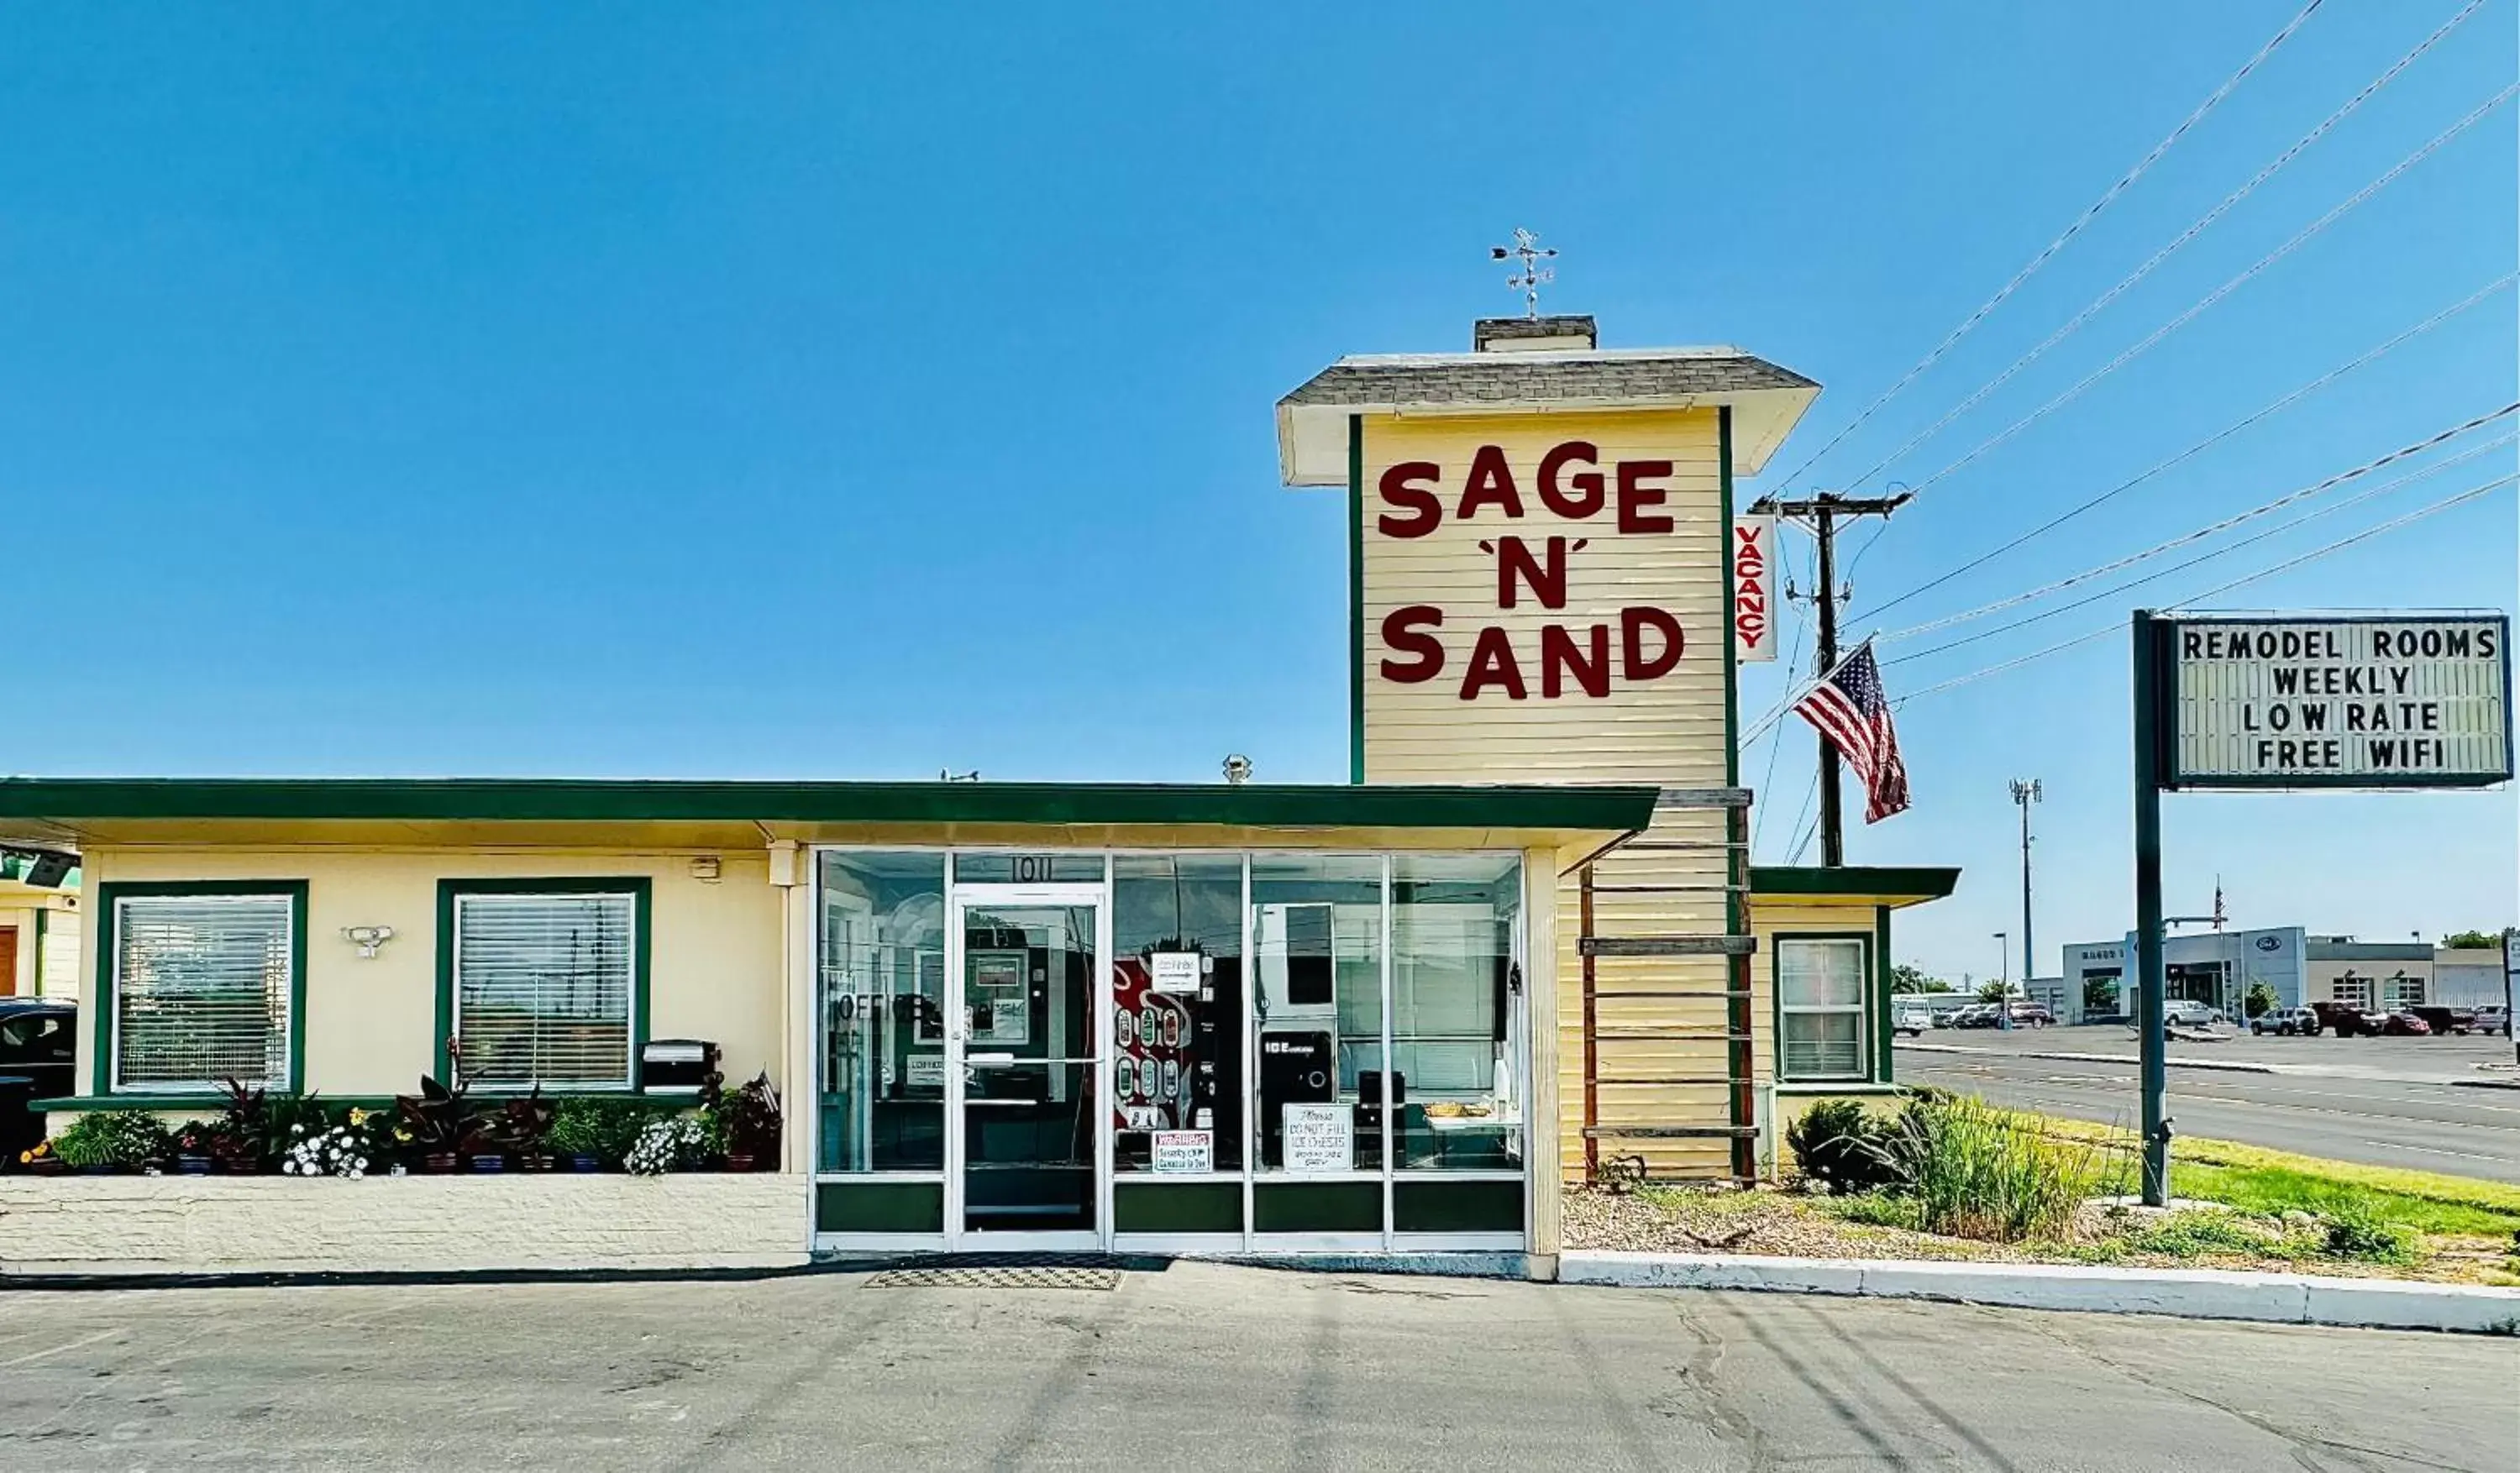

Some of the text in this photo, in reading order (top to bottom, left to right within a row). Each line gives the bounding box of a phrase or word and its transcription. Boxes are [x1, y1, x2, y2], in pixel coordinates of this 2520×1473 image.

[1378, 441, 1674, 538] SAGE
[1735, 526, 1766, 648] VACANCY
[1381, 605, 1684, 700] SAND
[2184, 629, 2496, 659] REMODEL ROOMS
[2273, 667, 2409, 695] WEEKLY
[2244, 703, 2439, 731] LOW RATE
[2257, 739, 2443, 768] FREE WIFI
[1012, 856, 1052, 882] 1011
